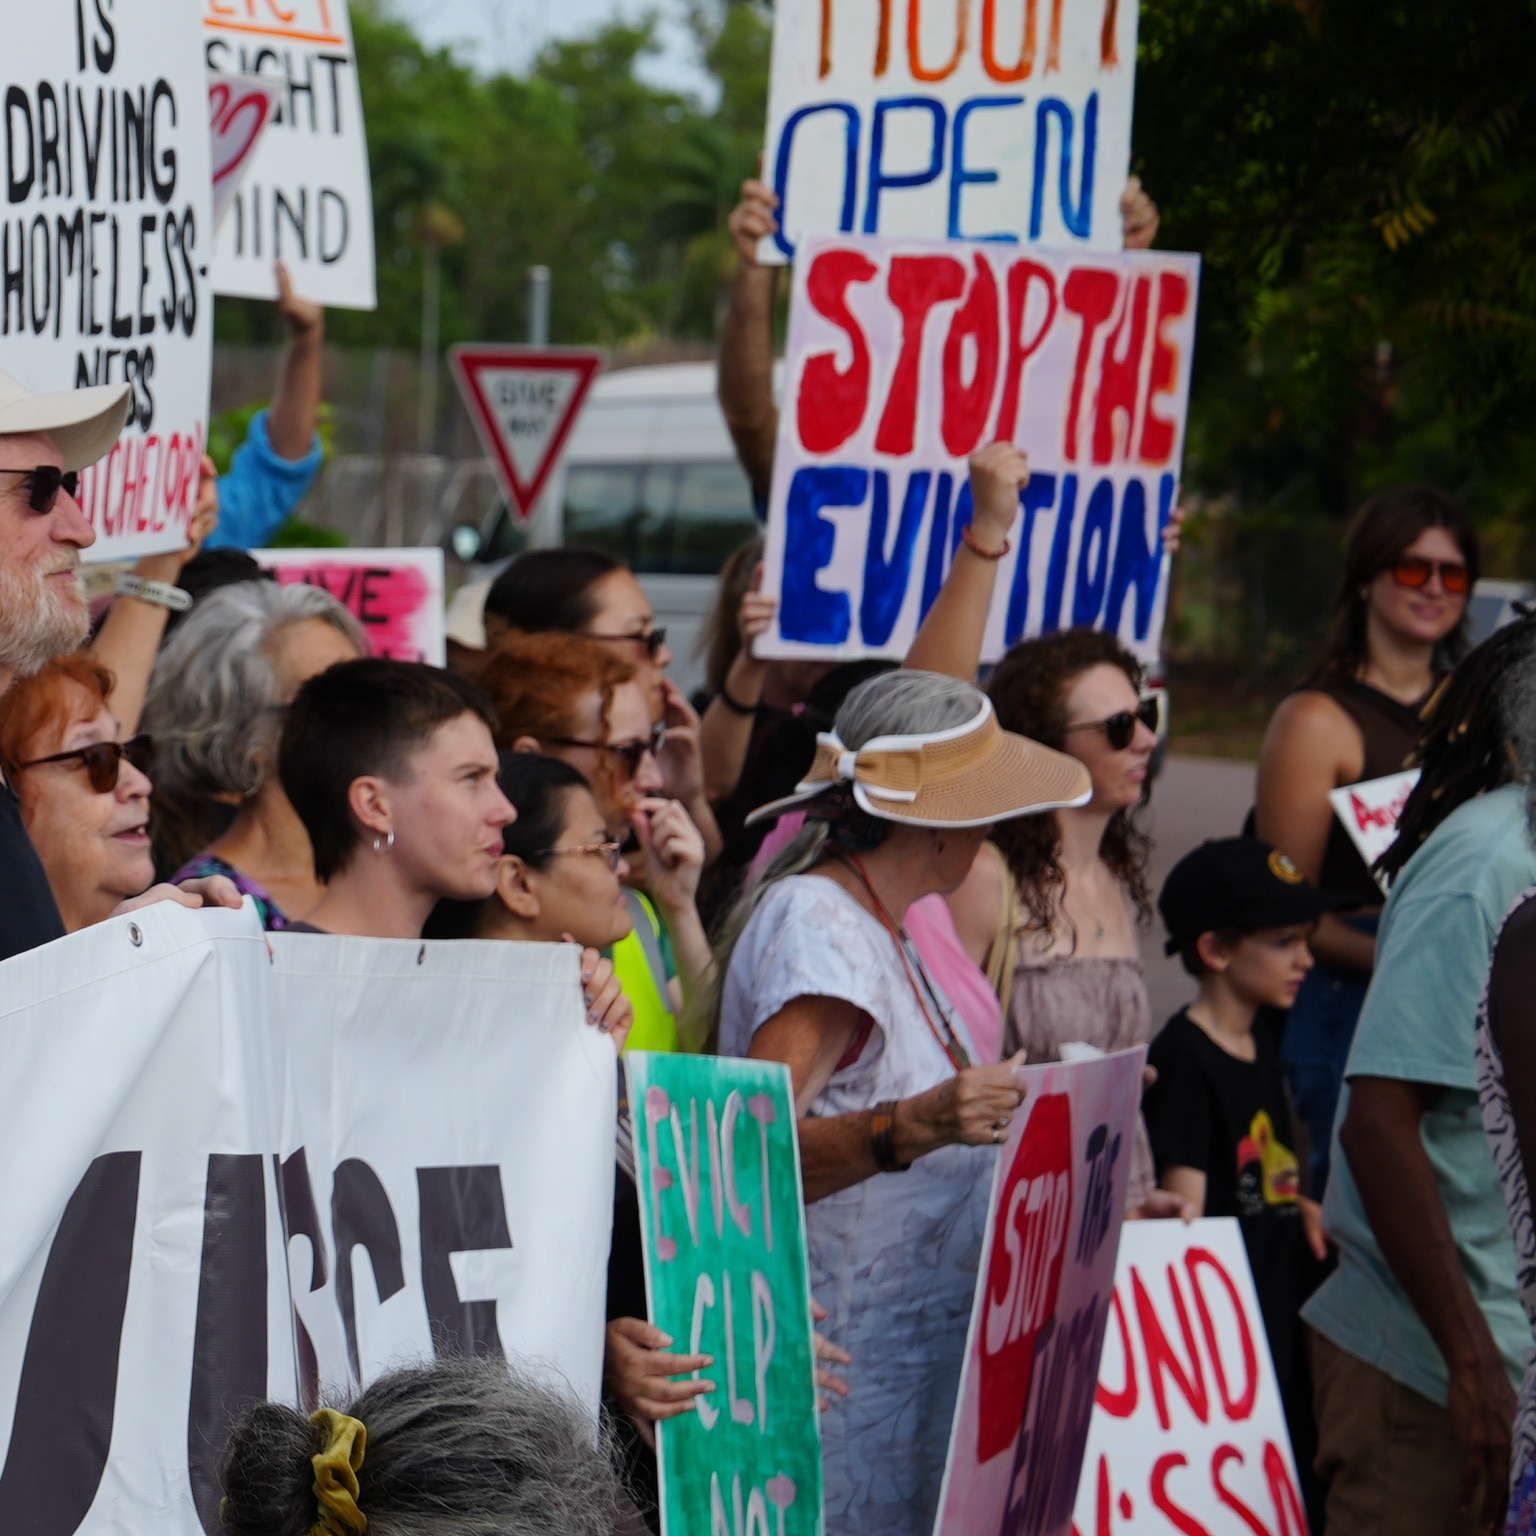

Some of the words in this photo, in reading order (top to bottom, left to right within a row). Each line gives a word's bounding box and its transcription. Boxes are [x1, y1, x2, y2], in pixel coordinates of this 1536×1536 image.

[3, 77, 177, 206] DRIVING
[772, 89, 1099, 255] OPEN
[798, 247, 1059, 459] STOP
[1061, 266, 1190, 465] THE
[645, 1085, 776, 1262] EVICT
[986, 1168, 1070, 1357] STOP
[691, 1268, 776, 1435] CLP
